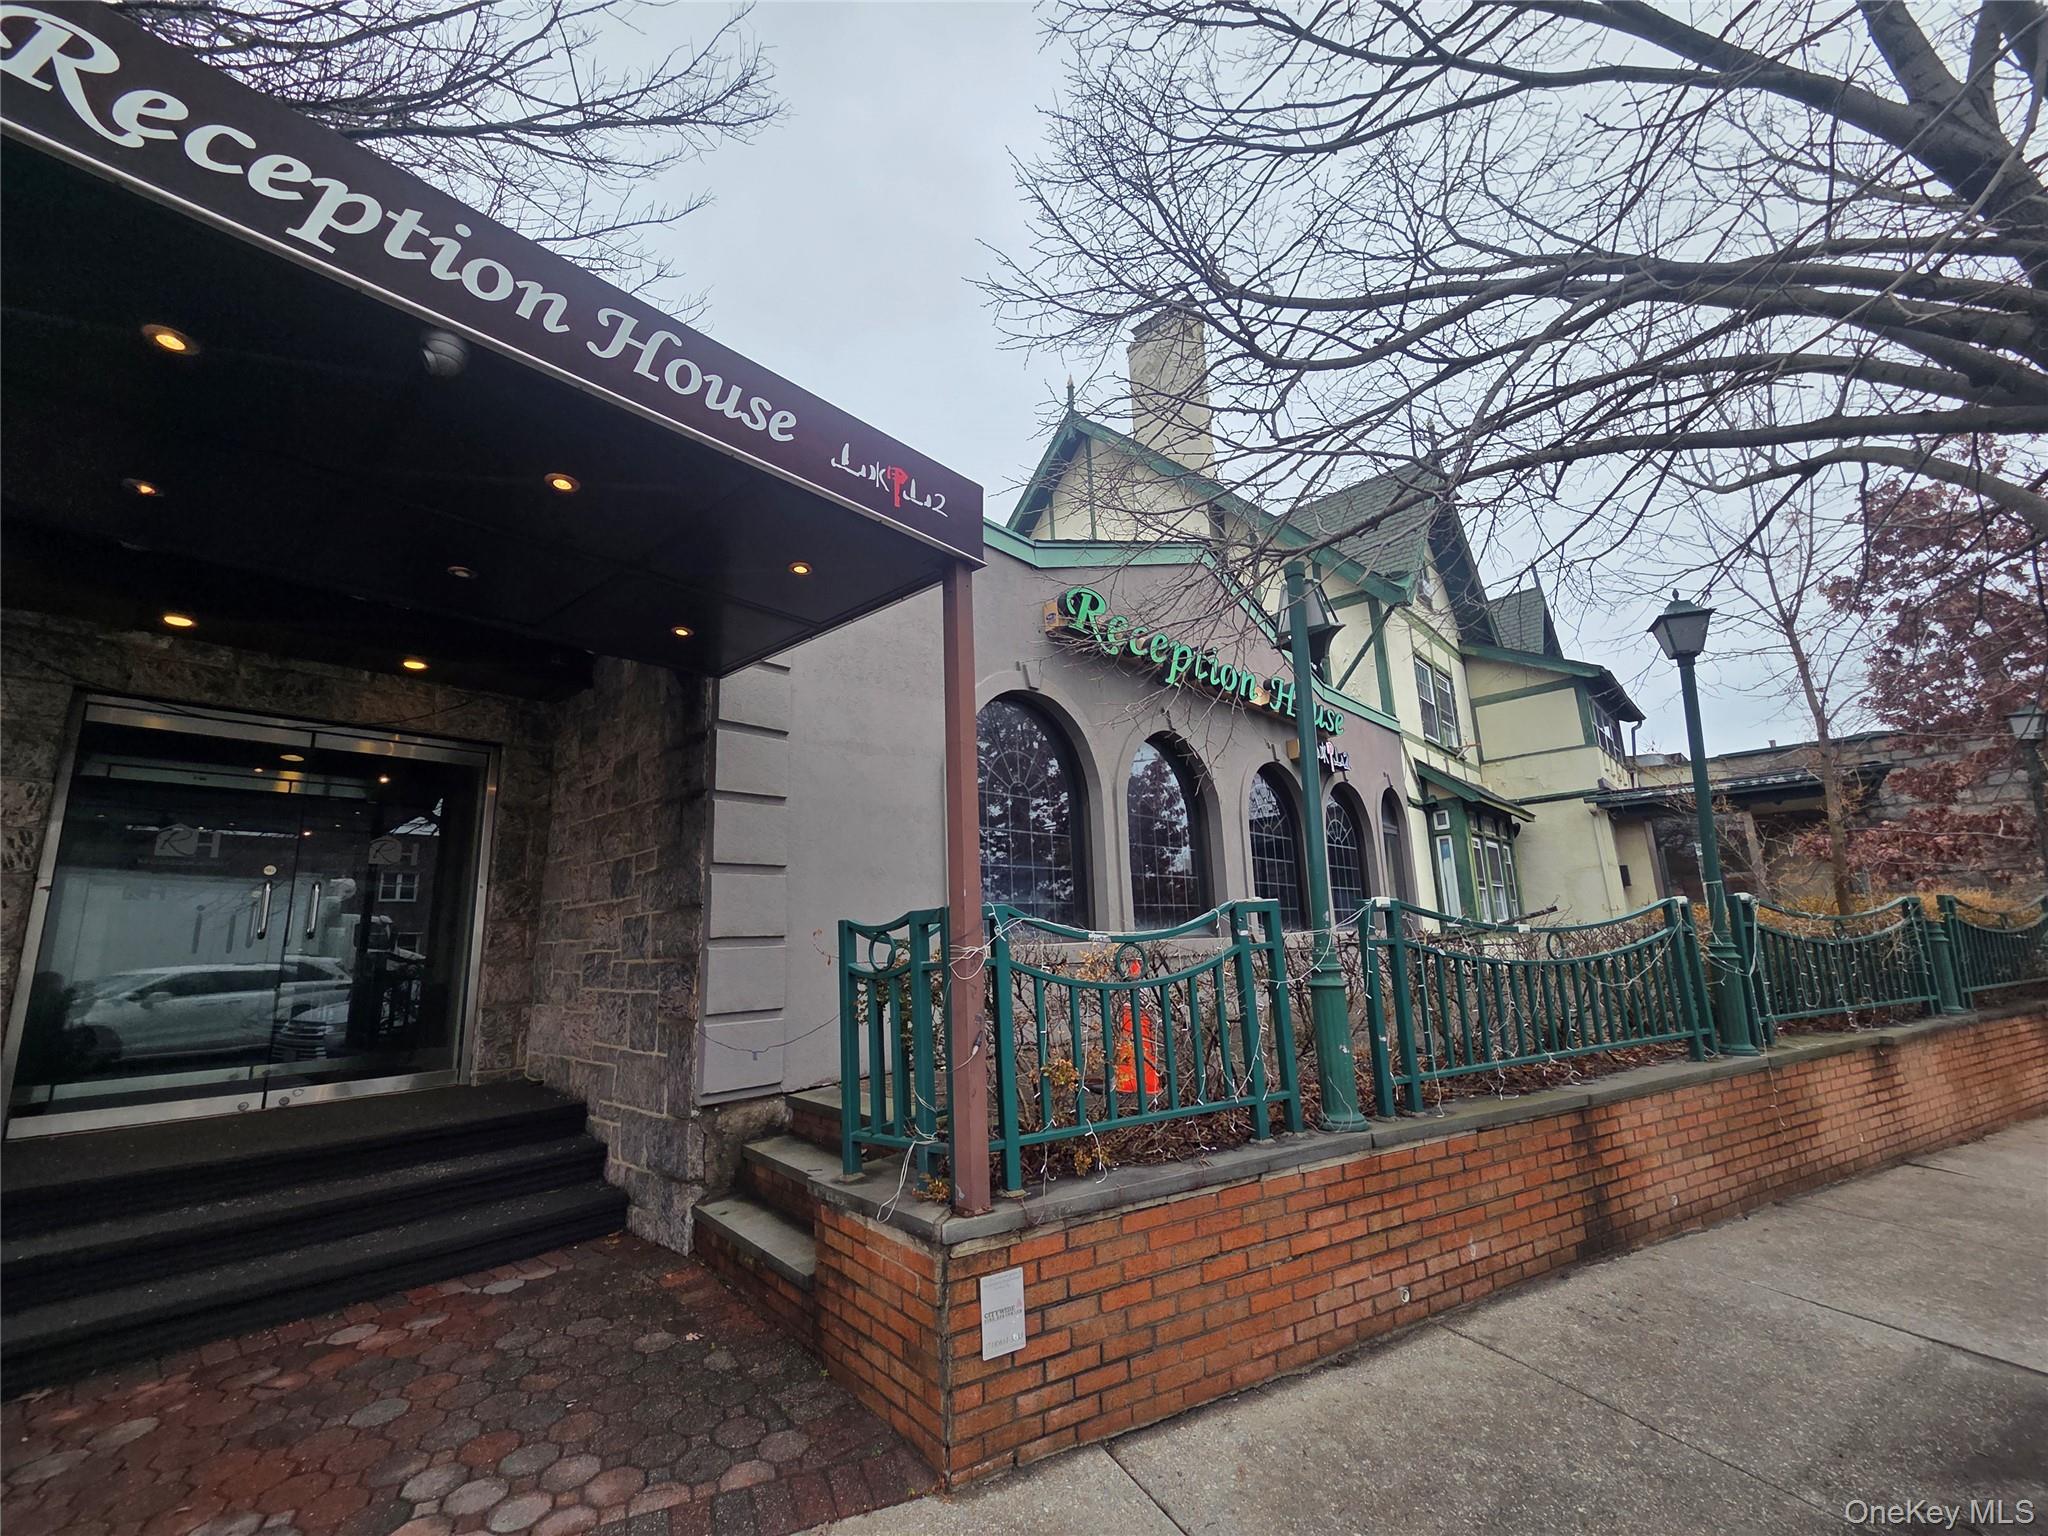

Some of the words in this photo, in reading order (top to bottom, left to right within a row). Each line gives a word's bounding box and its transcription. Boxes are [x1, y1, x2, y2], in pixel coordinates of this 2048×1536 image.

[0, 4, 570, 334] Reception
[586, 307, 797, 442] House
[1065, 586, 1258, 700] Reception
[1269, 676, 1344, 736] Huse
